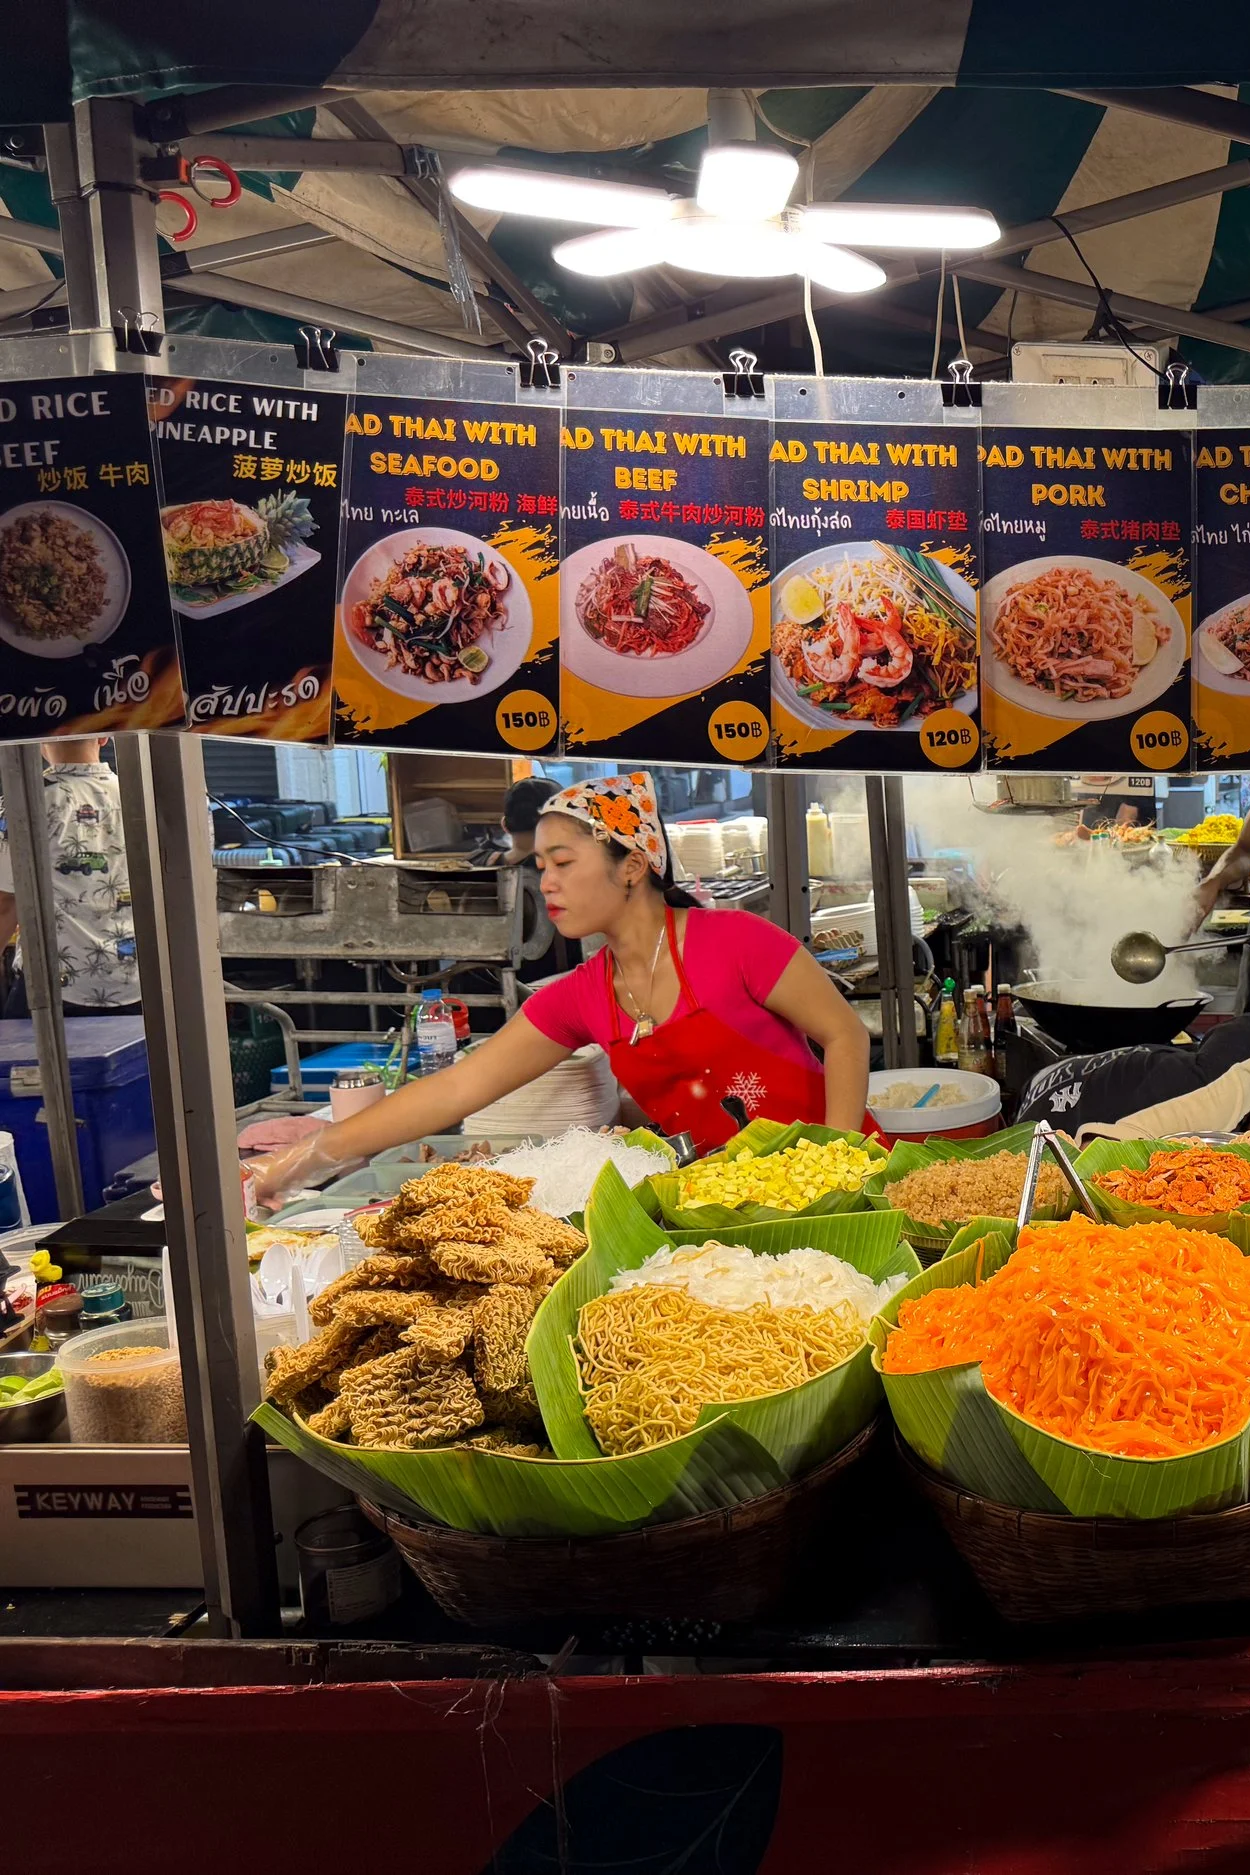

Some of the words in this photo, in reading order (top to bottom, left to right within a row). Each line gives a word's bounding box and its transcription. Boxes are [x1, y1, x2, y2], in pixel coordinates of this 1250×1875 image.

[31, 391, 111, 421] RICE
[186, 390, 243, 414] RICE
[253, 397, 319, 422] WITH
[389, 415, 457, 442] THAI
[463, 420, 537, 447] WITH
[600, 428, 667, 454] THAI
[673, 432, 747, 459] WITH
[0, 440, 61, 469] EEF
[370, 451, 500, 482] SEAFOOD
[813, 441, 880, 465] THAI
[886, 443, 958, 467] WITH
[1030, 446, 1096, 470] THAI
[1101, 447, 1173, 471] WITH
[38, 465, 90, 493] 炒饭
[99, 461, 151, 488] 牛肉
[232, 453, 338, 489] 菠萝炒饭
[614, 467, 679, 492] BEEF
[404, 486, 510, 514] 泰式炒河粉
[516, 492, 559, 517] 海鲜
[802, 478, 910, 502] SHRIMP
[1031, 483, 1107, 507] PORK
[381, 506, 421, 525] ทะเล
[618, 499, 766, 528] 泰式牛肉炒河粉
[885, 508, 968, 532] 泰国虾垫
[1079, 518, 1181, 541] 泰式猪肉垫
[94, 654, 150, 712] เนื้อ
[35, 1492, 136, 1511] KEYWAY
